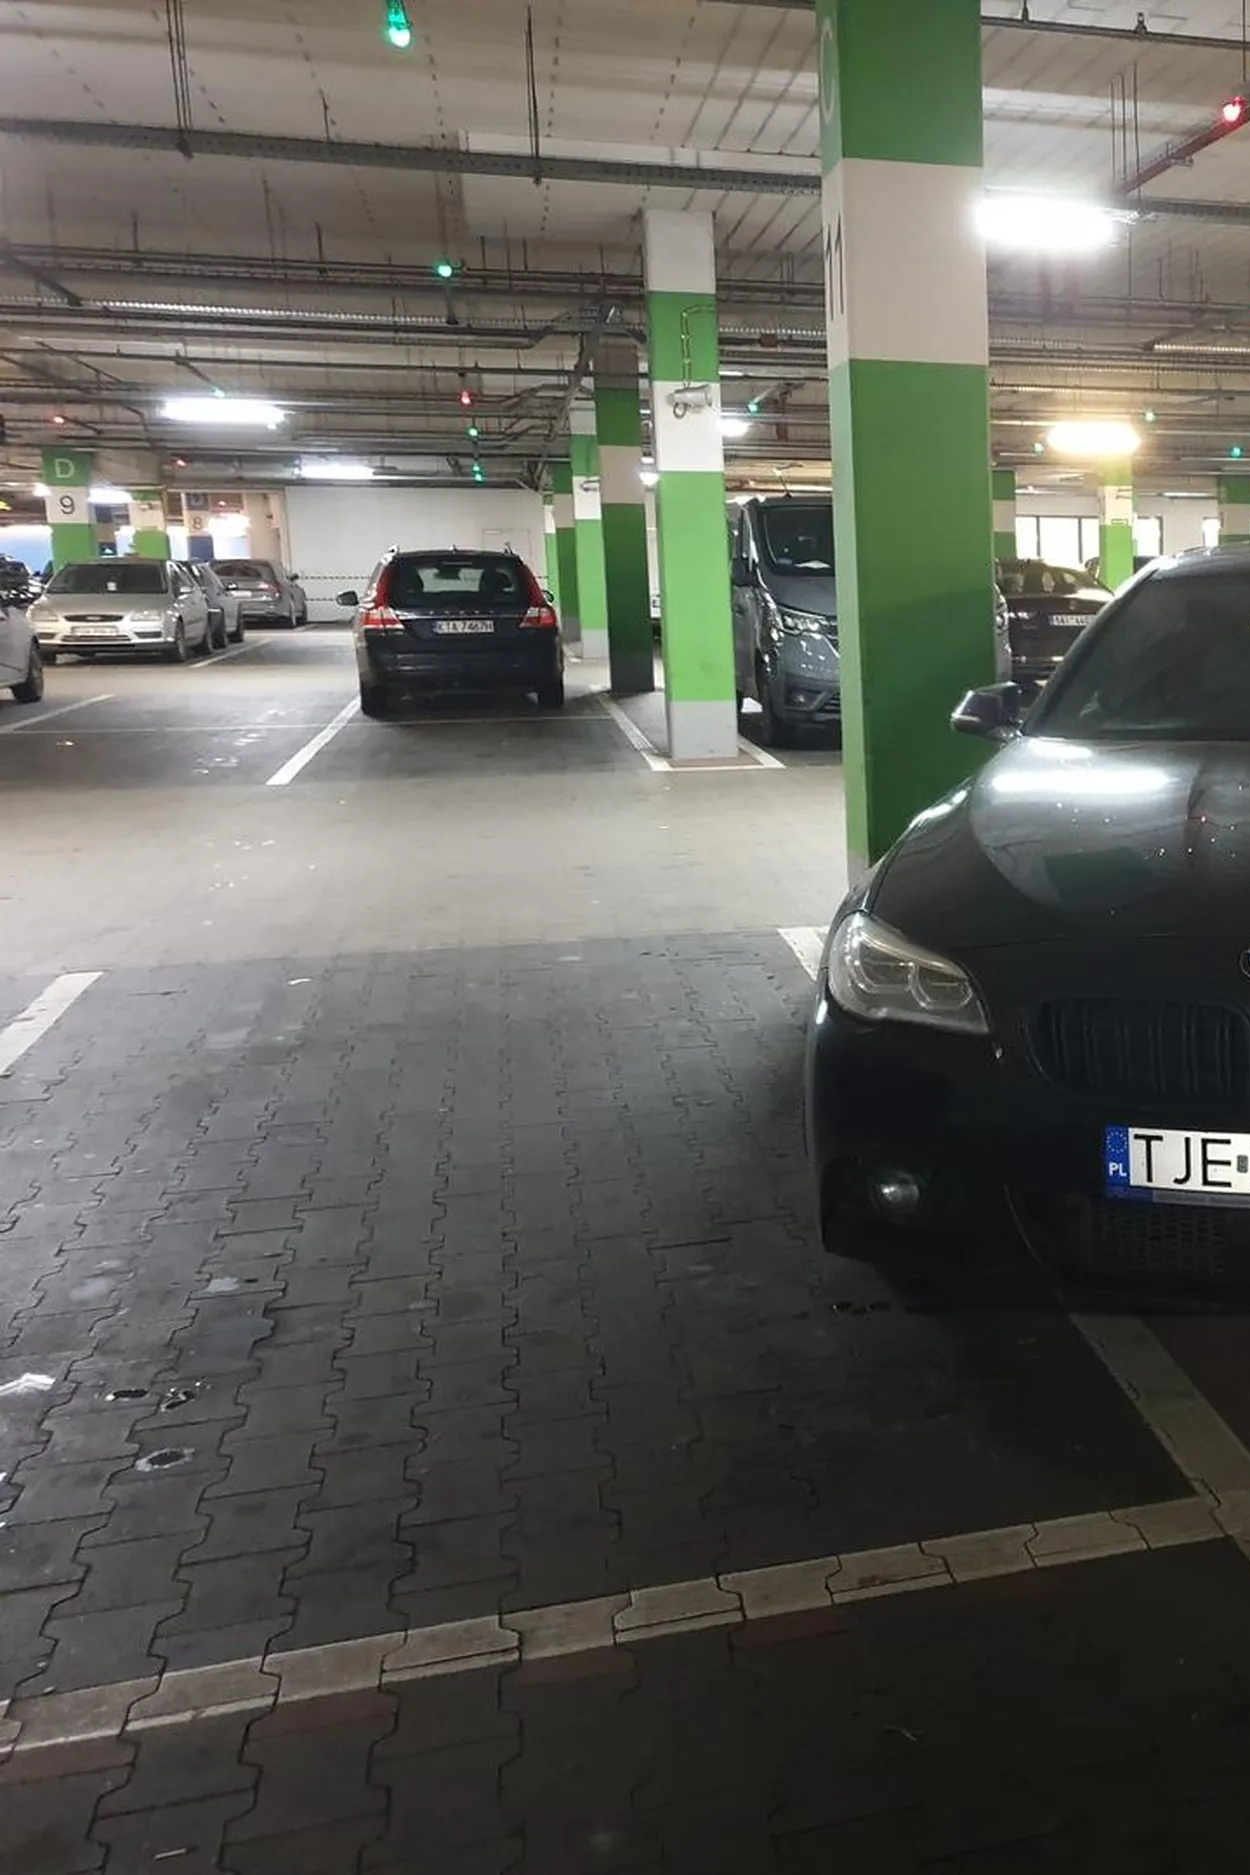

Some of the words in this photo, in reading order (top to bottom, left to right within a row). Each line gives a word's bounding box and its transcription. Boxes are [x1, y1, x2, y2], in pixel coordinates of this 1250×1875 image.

[825, 212, 845, 321] 11
[55, 458, 75, 479] D
[59, 495, 75, 515] 9
[1109, 1163, 1127, 1177] PL
[1133, 1133, 1232, 1188] TJE
